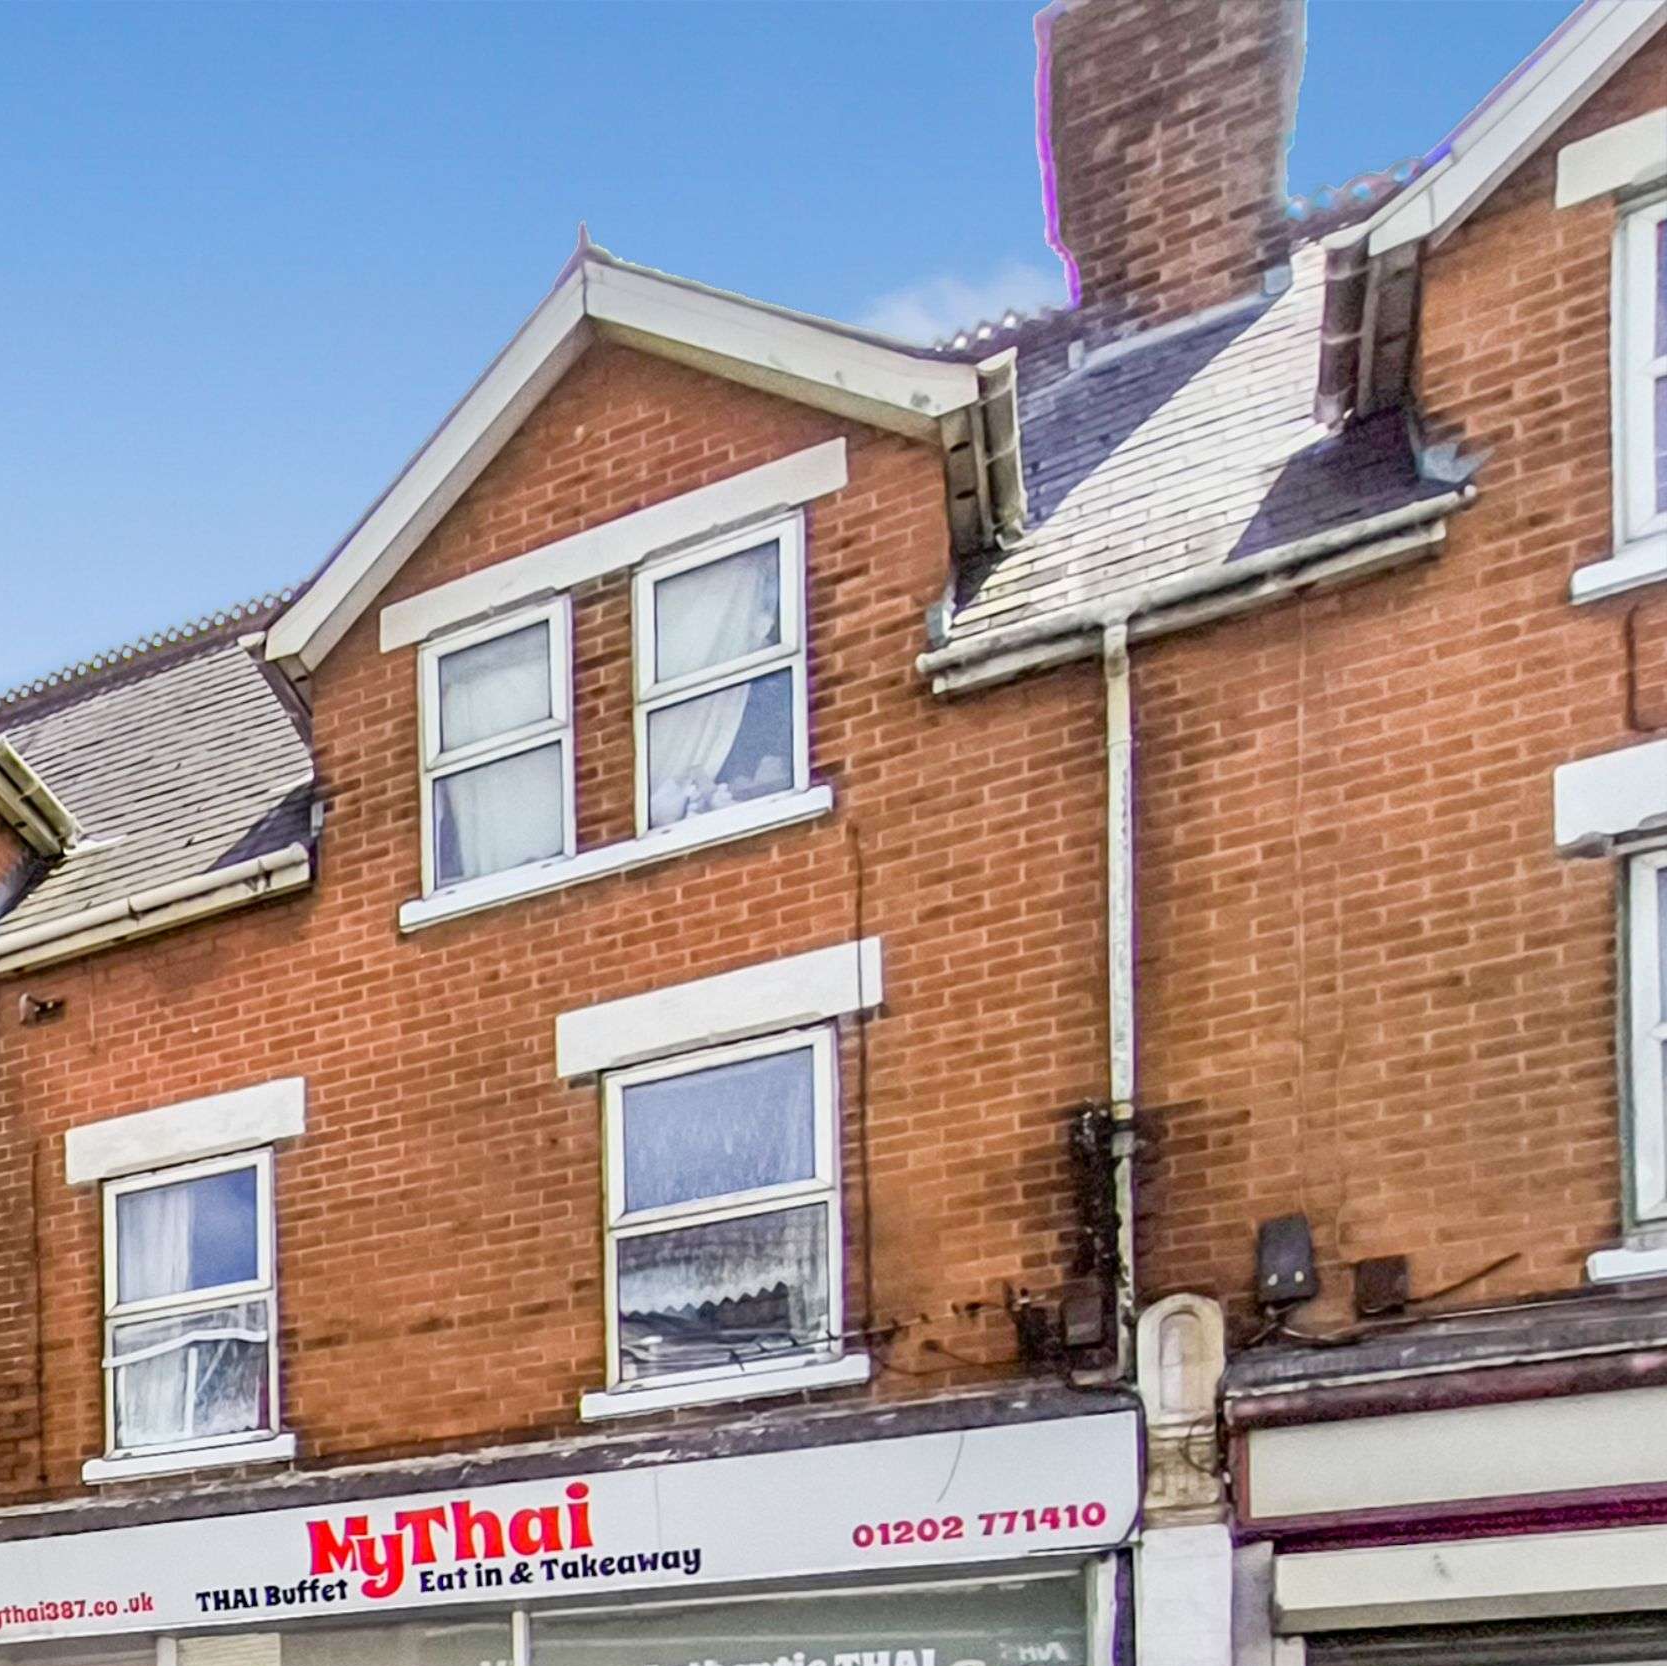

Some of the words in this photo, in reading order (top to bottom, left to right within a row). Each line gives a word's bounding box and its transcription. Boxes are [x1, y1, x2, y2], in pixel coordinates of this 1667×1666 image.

[852, 1516, 965, 1549] 01202
[978, 1502, 1107, 1537] 771410
[419, 1566, 468, 1593] Eat
[475, 1562, 500, 1588] in
[510, 1561, 534, 1584] &
[540, 1548, 702, 1584] Takeaway
[195, 1588, 260, 1612] THAI
[264, 1579, 348, 1609] Buffet
